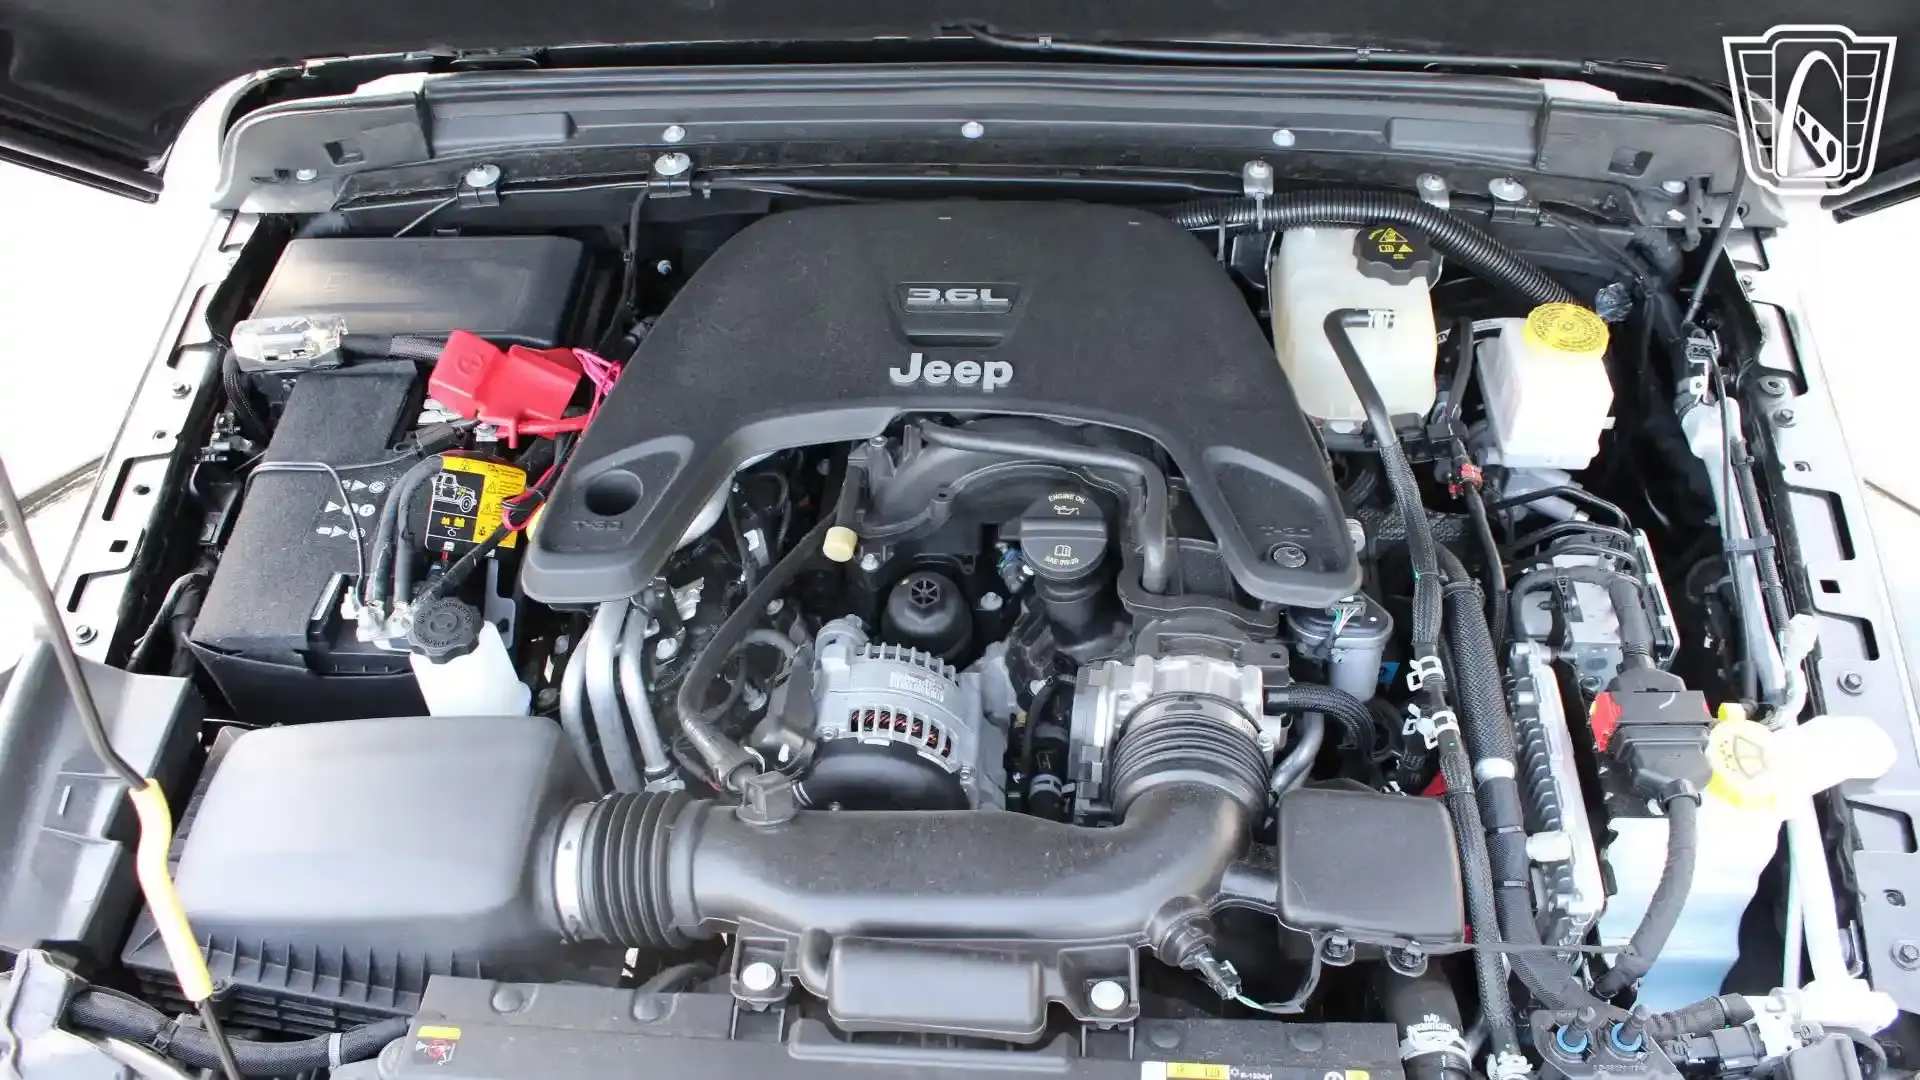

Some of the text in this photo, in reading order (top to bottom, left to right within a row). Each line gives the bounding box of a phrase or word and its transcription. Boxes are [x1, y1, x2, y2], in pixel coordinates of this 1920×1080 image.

[906, 288, 1009, 305] 3.6L
[889, 352, 1014, 393] Jeep
[1048, 493, 1086, 505] ENGINE OIL
